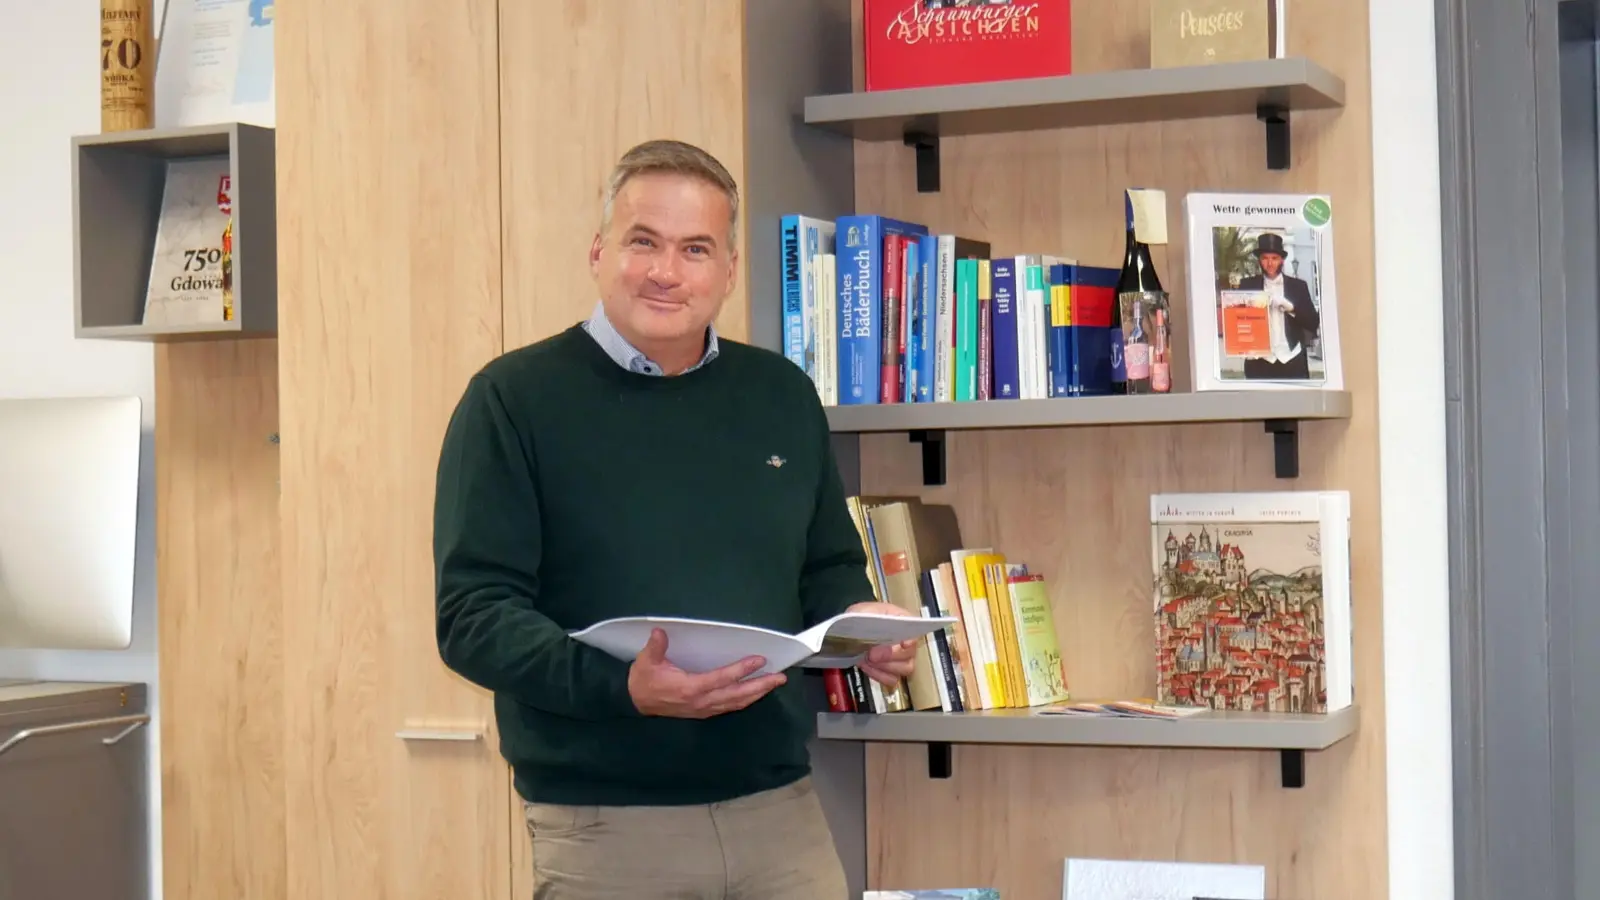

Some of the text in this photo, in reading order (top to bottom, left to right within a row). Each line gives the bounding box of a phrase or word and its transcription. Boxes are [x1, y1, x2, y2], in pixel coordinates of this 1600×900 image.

[897, 15, 1040, 39] ANSICHTEN
[1180, 7, 1244, 39] Pensées
[102, 37, 142, 71] 70
[1213, 203, 1242, 214] Wette
[1245, 204, 1296, 217] gewonnen
[184, 248, 222, 272] 750
[785, 225, 799, 283] TIMM
[854, 249, 871, 338] Bäderbuch
[938, 252, 949, 316] Niedersachsen
[840, 273, 853, 339] Deutsches
